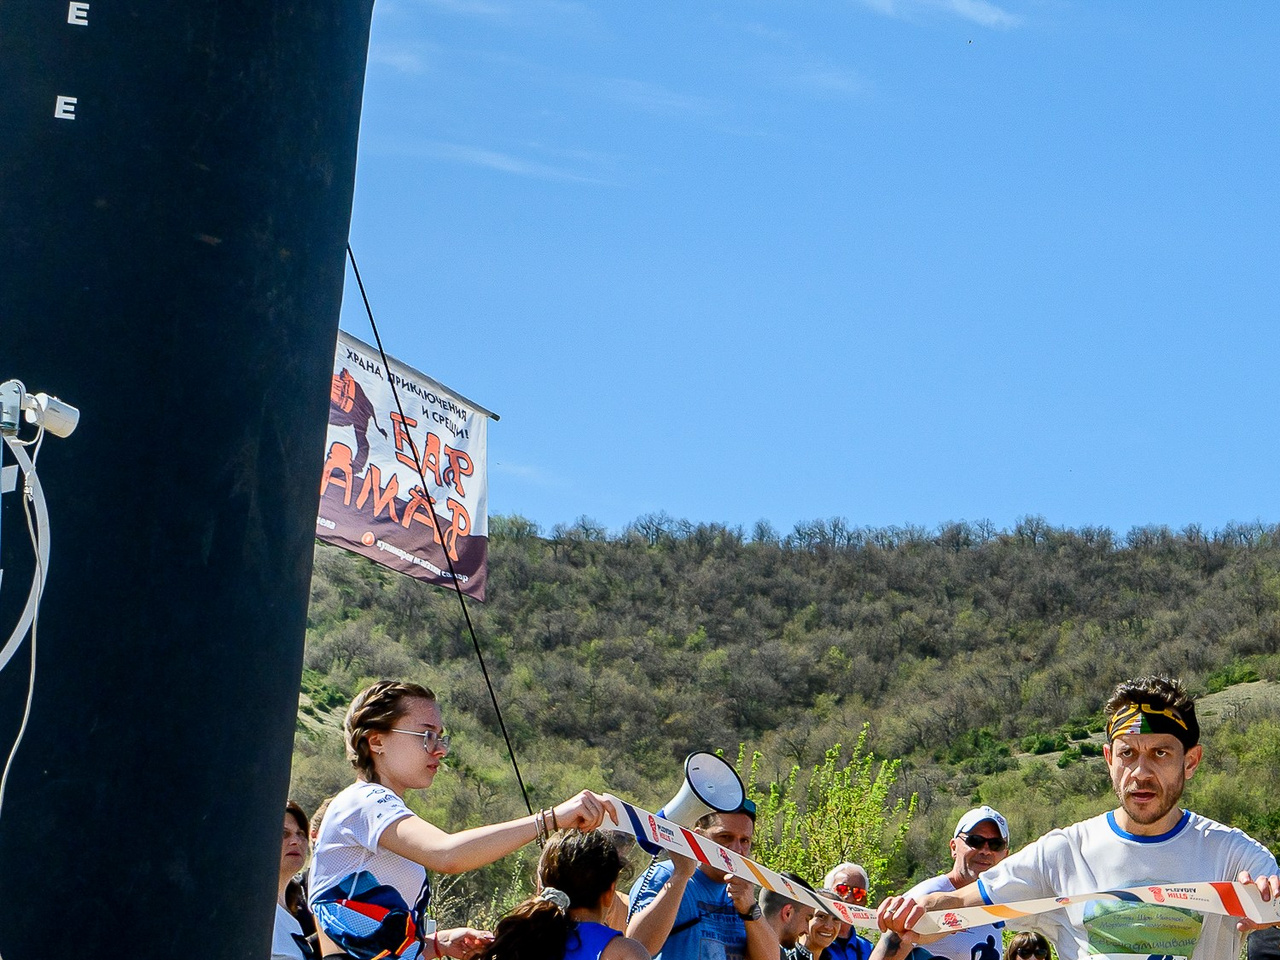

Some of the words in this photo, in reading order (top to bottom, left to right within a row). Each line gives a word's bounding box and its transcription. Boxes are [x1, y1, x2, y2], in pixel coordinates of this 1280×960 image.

[67, 1, 90, 26] E
[54, 95, 77, 120] E
[346, 348, 384, 381] ХРАНА,
[387, 372, 468, 423] ПРИКЛЮЧЕНИЯ
[421, 405, 429, 420] И
[432, 411, 470, 440] СРЕЩИ!
[389, 410, 475, 498] БАР
[319, 441, 472, 562] АМАР
